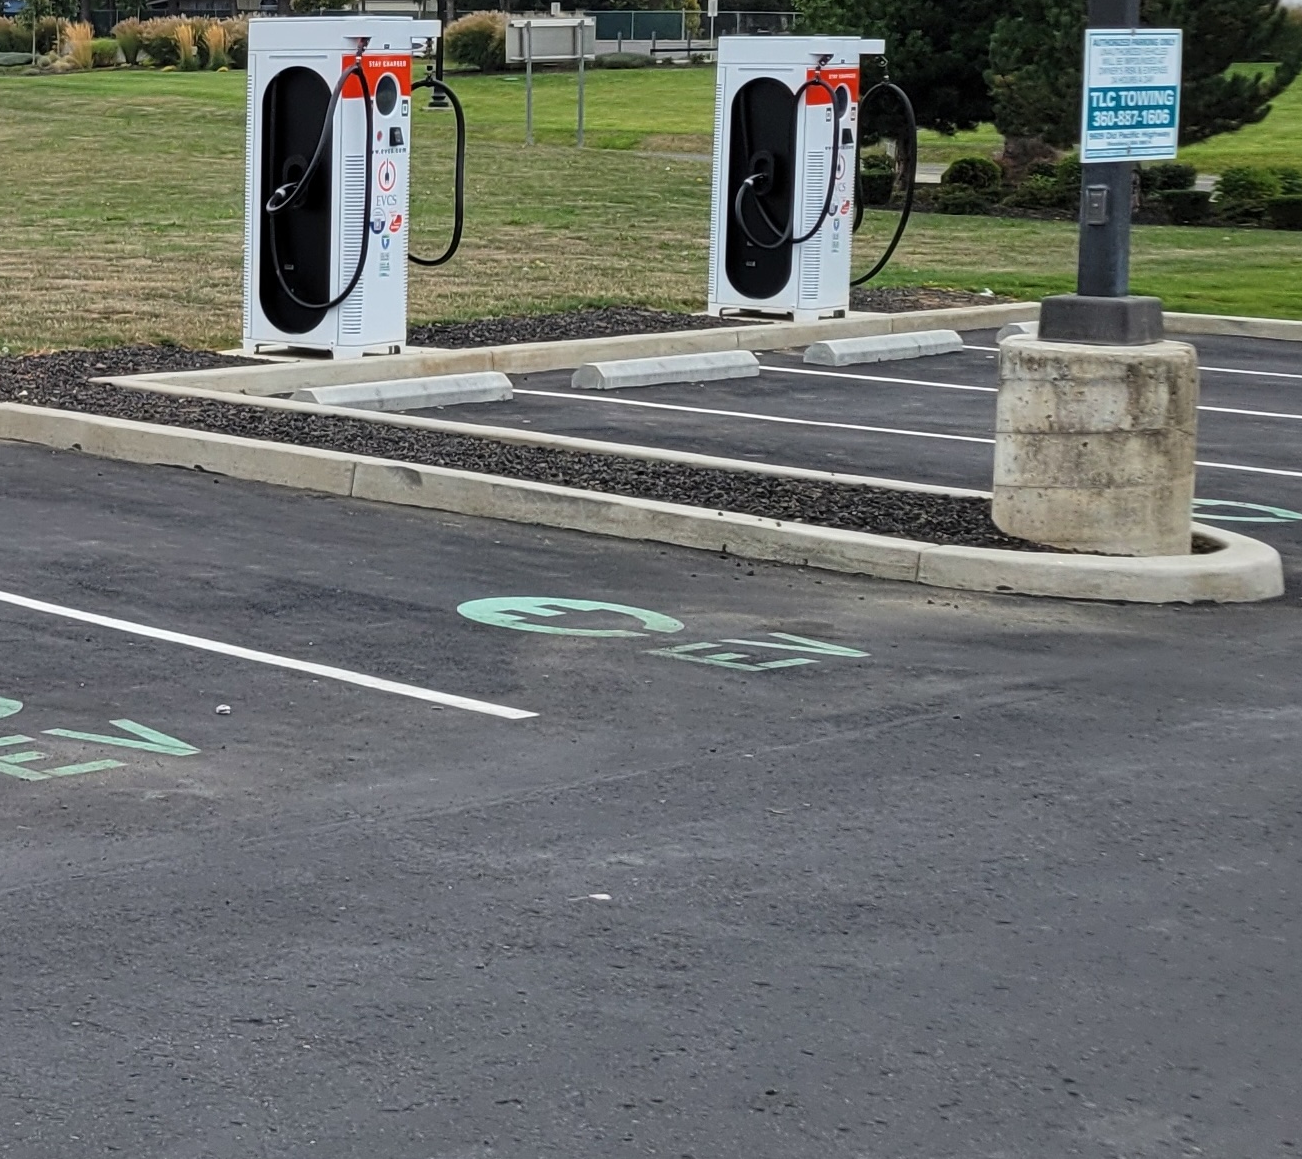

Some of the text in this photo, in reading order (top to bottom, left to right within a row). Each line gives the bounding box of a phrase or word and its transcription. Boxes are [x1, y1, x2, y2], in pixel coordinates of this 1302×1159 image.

[1090, 90, 1174, 107] TLC TOWING
[376, 195, 397, 206] EVCS
[641, 632, 872, 671] EV
